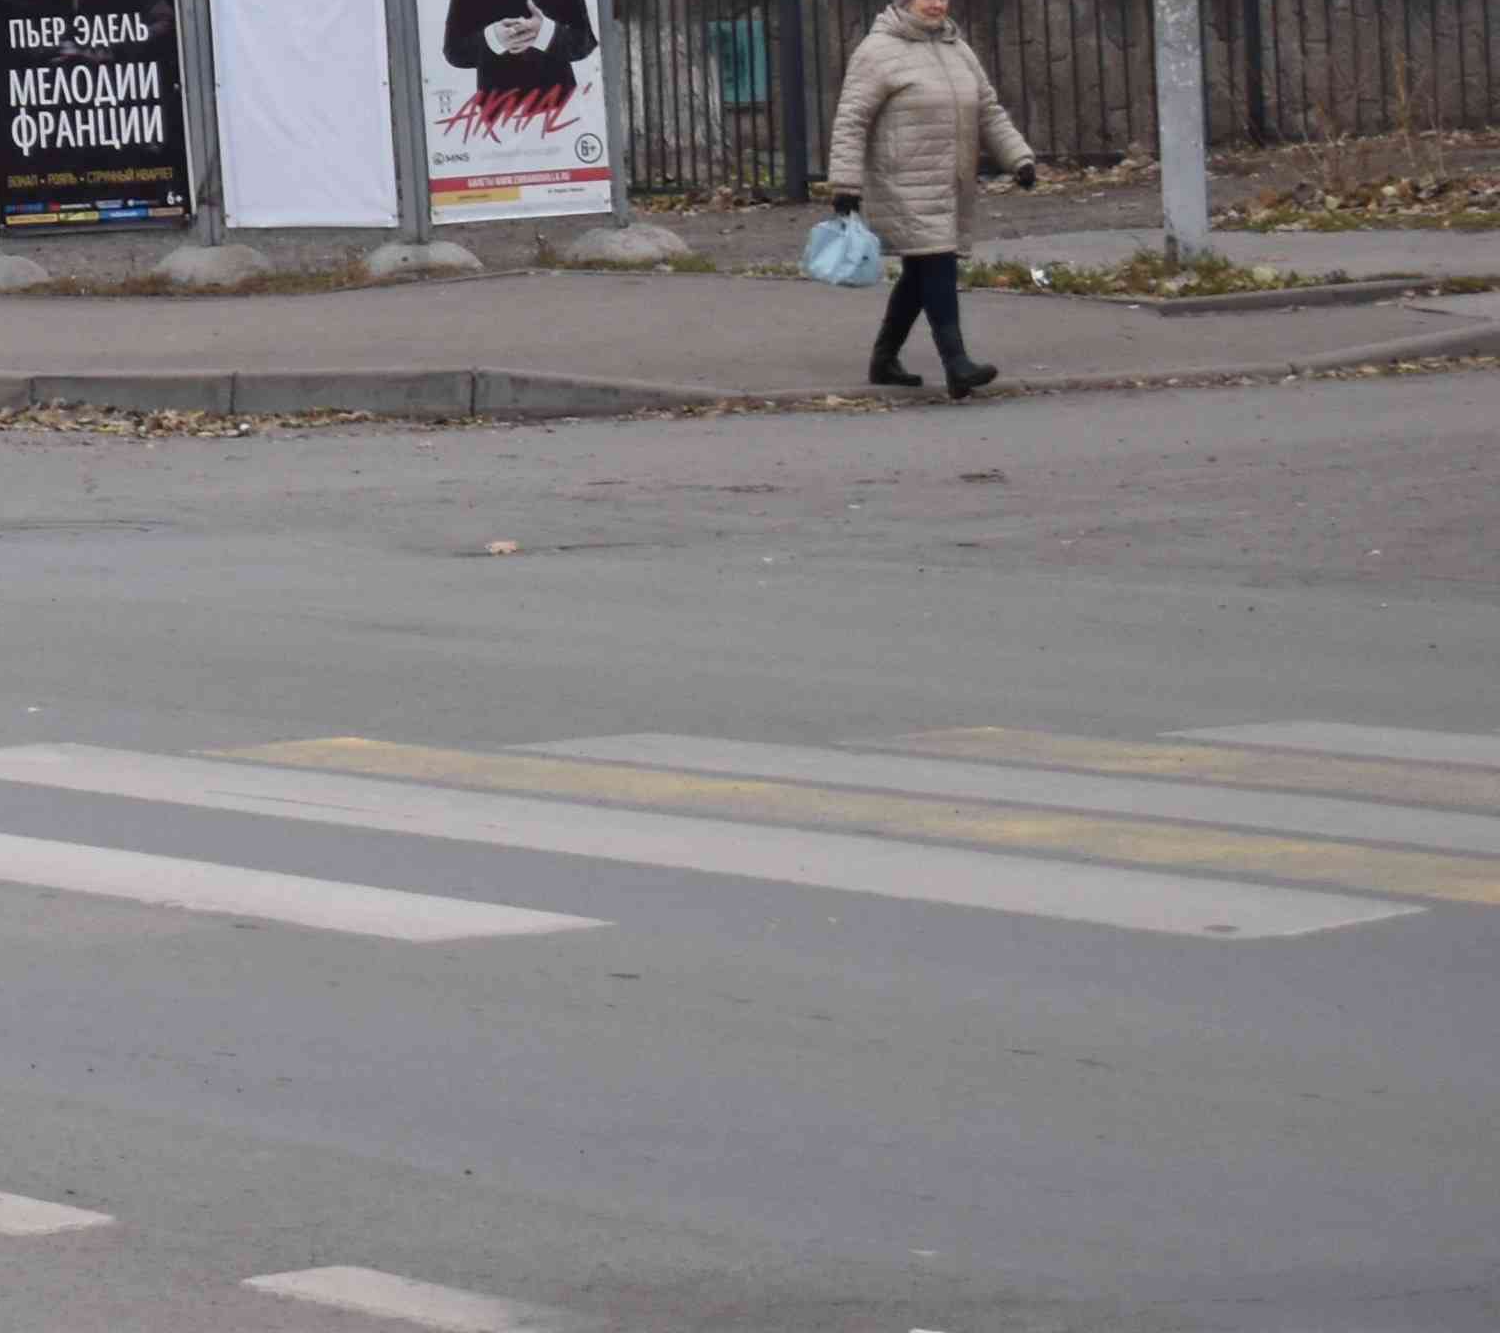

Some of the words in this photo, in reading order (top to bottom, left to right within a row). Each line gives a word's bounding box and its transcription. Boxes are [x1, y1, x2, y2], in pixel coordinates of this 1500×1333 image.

[8, 16, 66, 49] ПЬЕР
[73, 12, 149, 48] ЭДЕЛЬ
[9, 61, 160, 107] МЕЛОДИИ
[11, 105, 164, 157] ФРАНЦИИ
[580, 140, 597, 157] 6+
[166, 191, 183, 206] 6+
